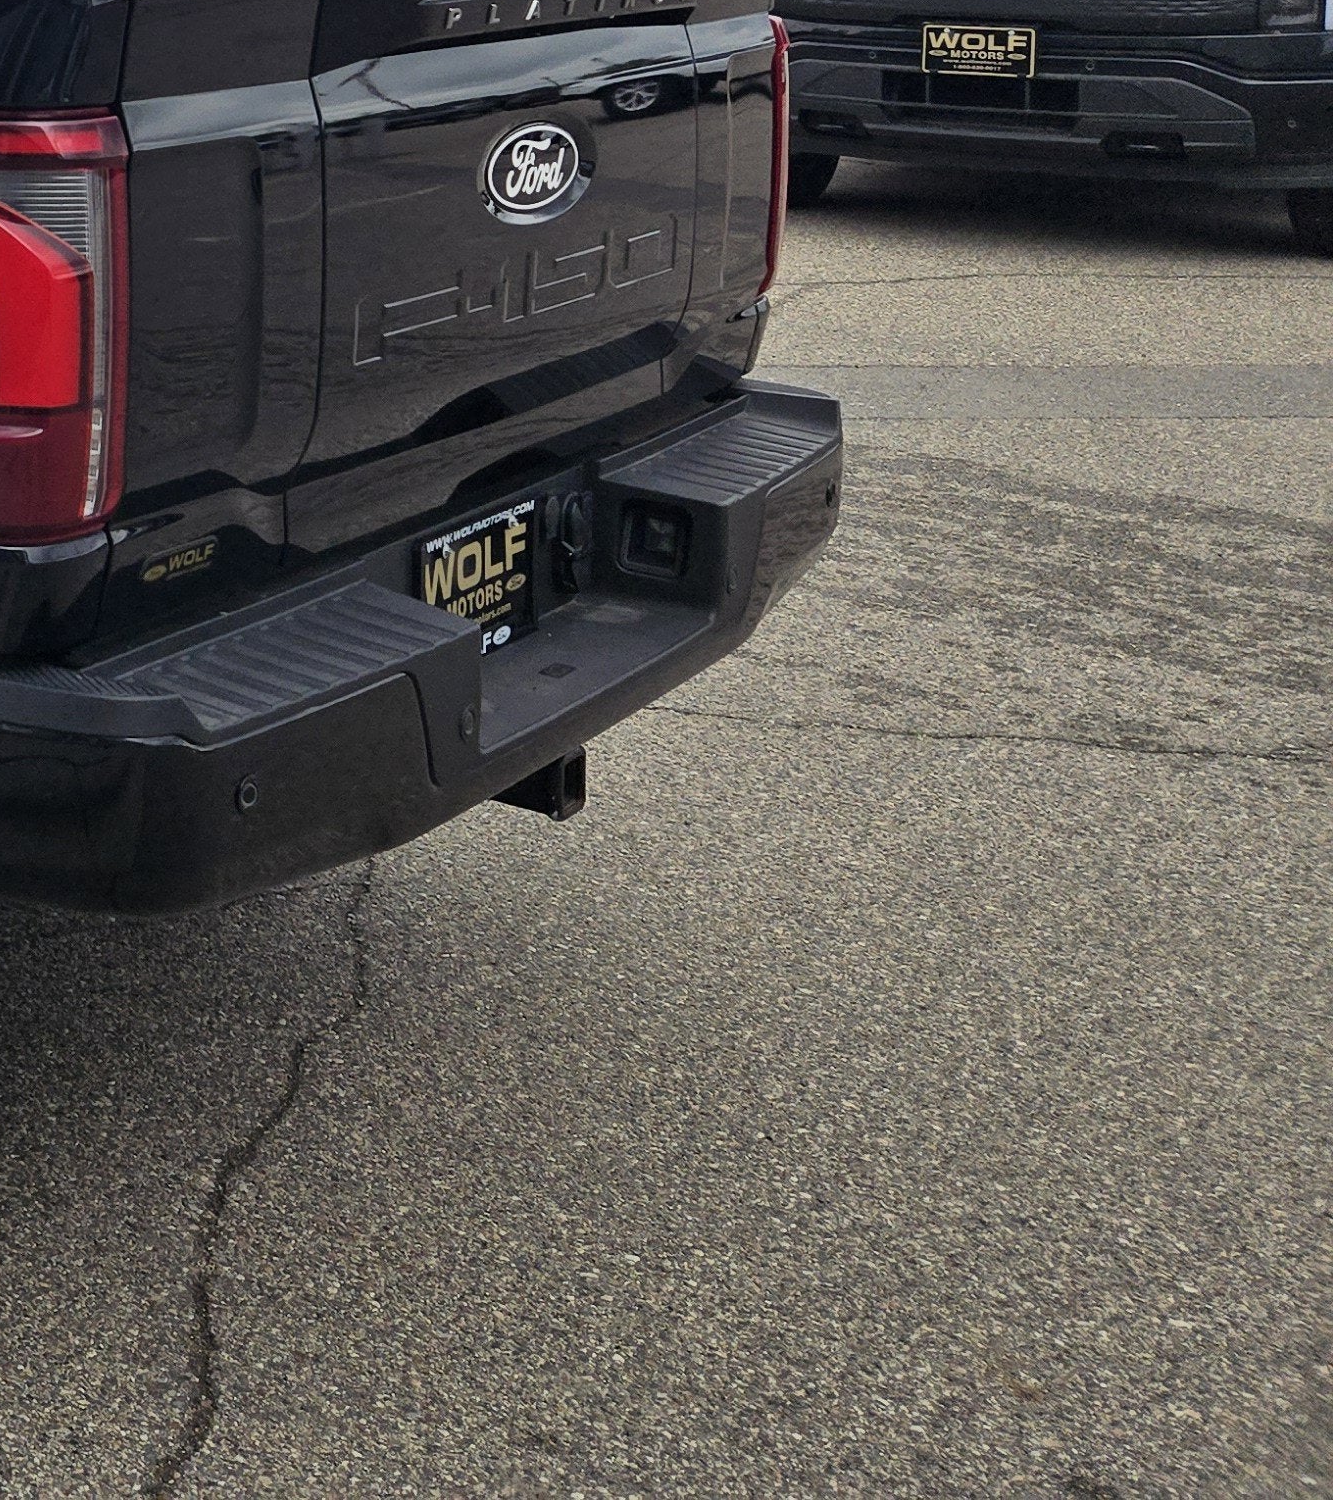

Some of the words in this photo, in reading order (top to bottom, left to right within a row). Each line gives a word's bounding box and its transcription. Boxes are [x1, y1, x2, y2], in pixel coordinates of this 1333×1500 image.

[929, 31, 1027, 51] WOLF
[950, 50, 1004, 60] MOTORS
[506, 137, 566, 198] Ford
[353, 213, 678, 366] F-150
[169, 543, 215, 571] WOLF
[425, 522, 527, 606] WOLF
[447, 580, 503, 618] MOTORS
